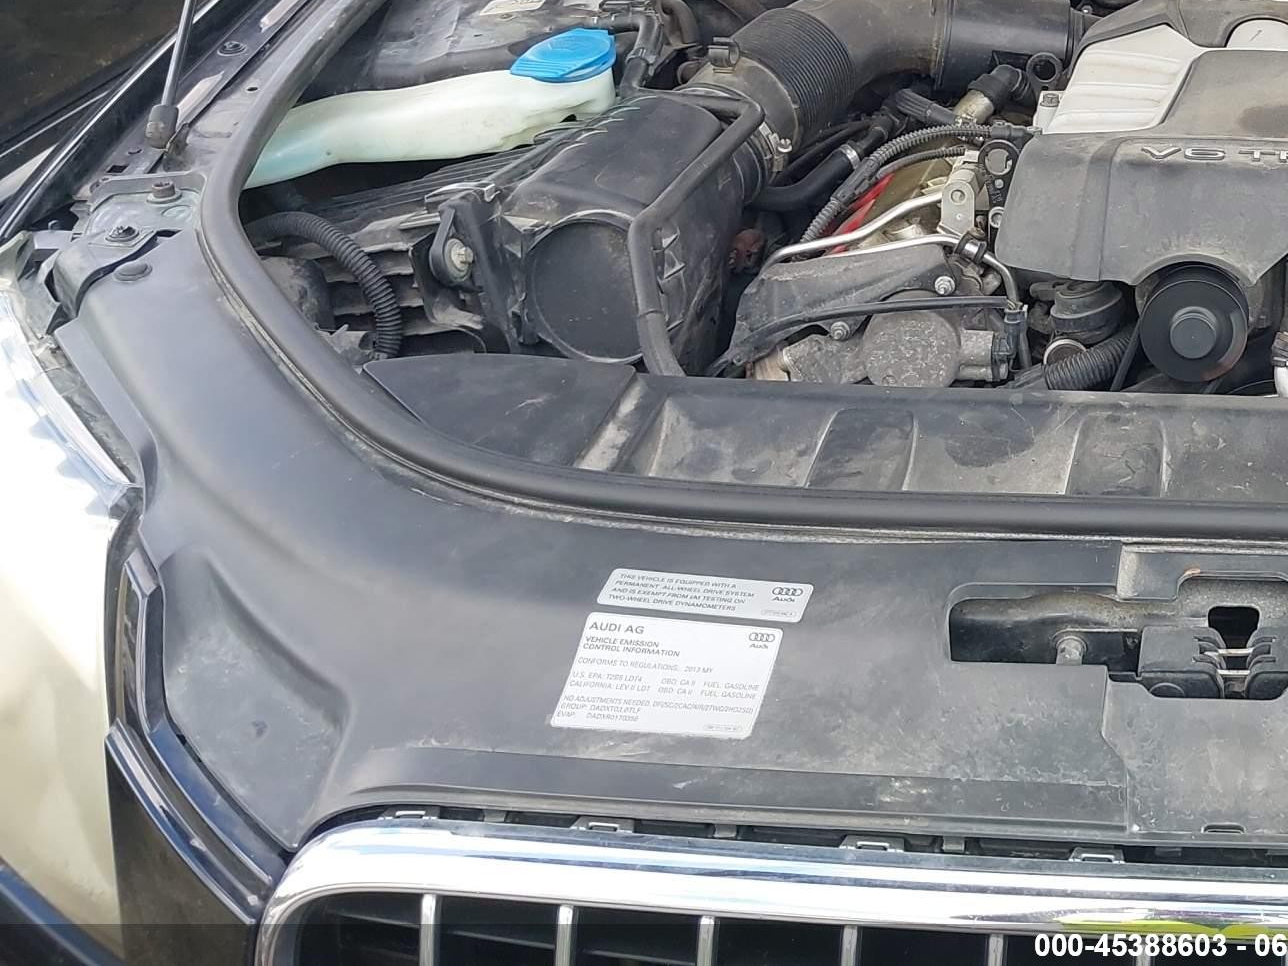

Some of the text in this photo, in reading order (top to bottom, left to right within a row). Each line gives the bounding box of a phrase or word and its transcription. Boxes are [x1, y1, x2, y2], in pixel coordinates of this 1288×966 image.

[1140, 146, 1225, 161] V6
[637, 575, 665, 583] VEHICLE
[615, 580, 659, 588] PERMANENT
[608, 594, 736, 611] TWO-WHEEL DRIVE DYNAMOMETERS
[589, 622, 645, 634] AUDI AG
[585, 636, 660, 648] VEHICLE EMISSION
[748, 642, 770, 650] Audi
[583, 642, 680, 657] CONTROL INFORMATION
[578, 657, 618, 666] CONFORMS
[724, 682, 760, 691] GASOLINE
[720, 691, 757, 699] GASOLINE
[575, 696, 622, 705] ADJUSTMENTS
